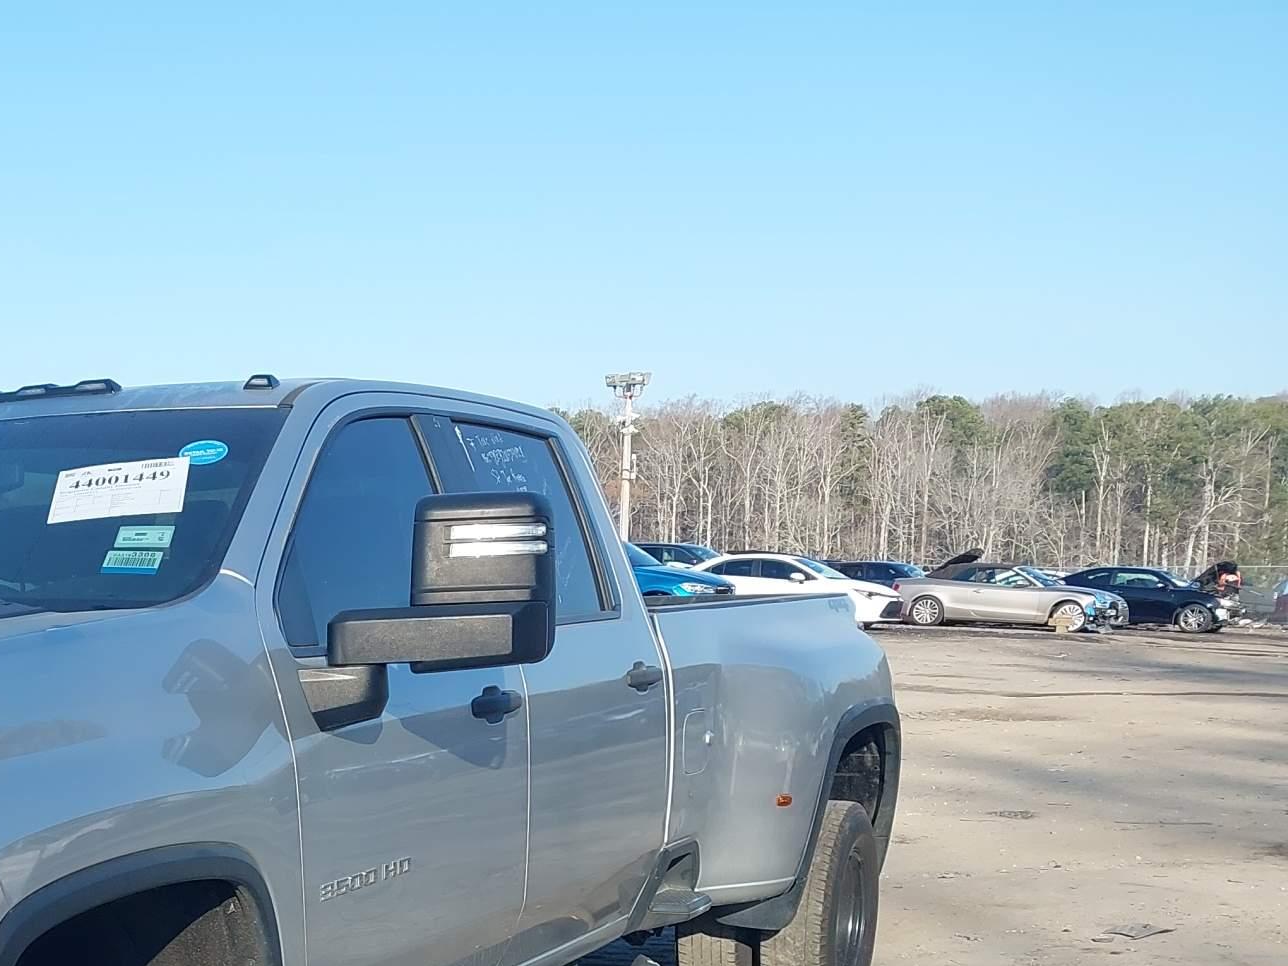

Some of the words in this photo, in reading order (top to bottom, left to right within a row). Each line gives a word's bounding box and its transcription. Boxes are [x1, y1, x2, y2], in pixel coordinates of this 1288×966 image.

[69, 470, 170, 489] 44001449
[319, 867, 377, 903] 3500
[381, 856, 412, 881] HD
